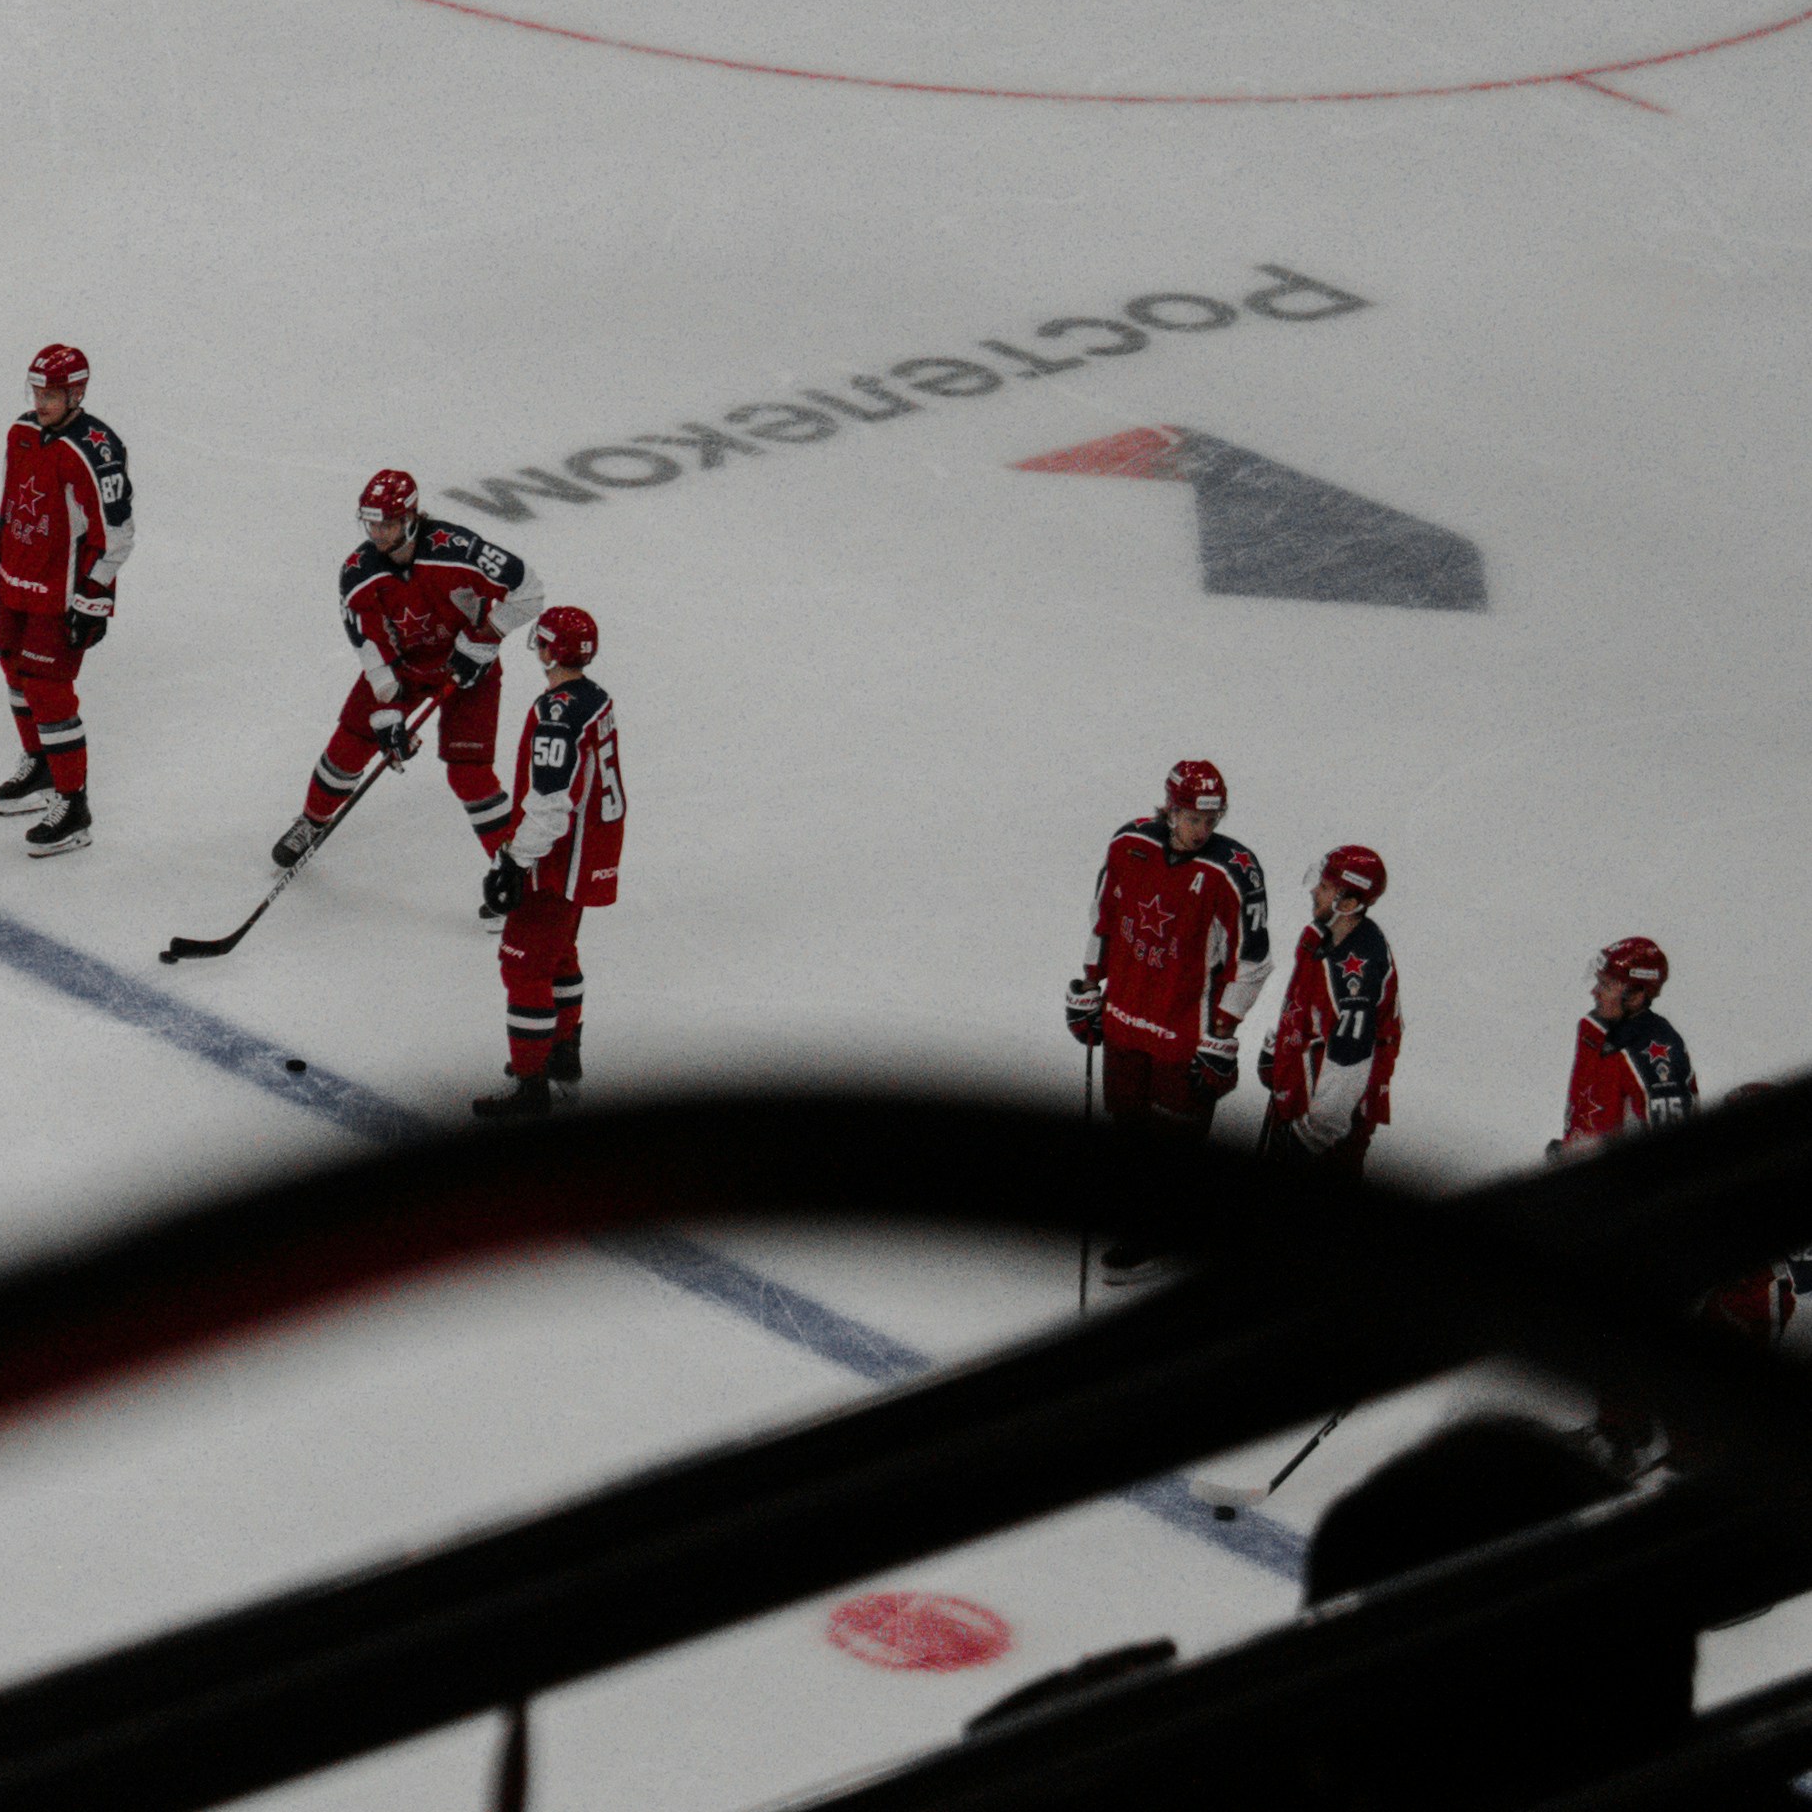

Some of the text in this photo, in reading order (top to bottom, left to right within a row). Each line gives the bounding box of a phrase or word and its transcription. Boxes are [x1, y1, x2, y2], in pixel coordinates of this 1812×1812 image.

[99, 472, 125, 505] 87
[474, 539, 505, 580] 35
[532, 734, 568, 769] 50
